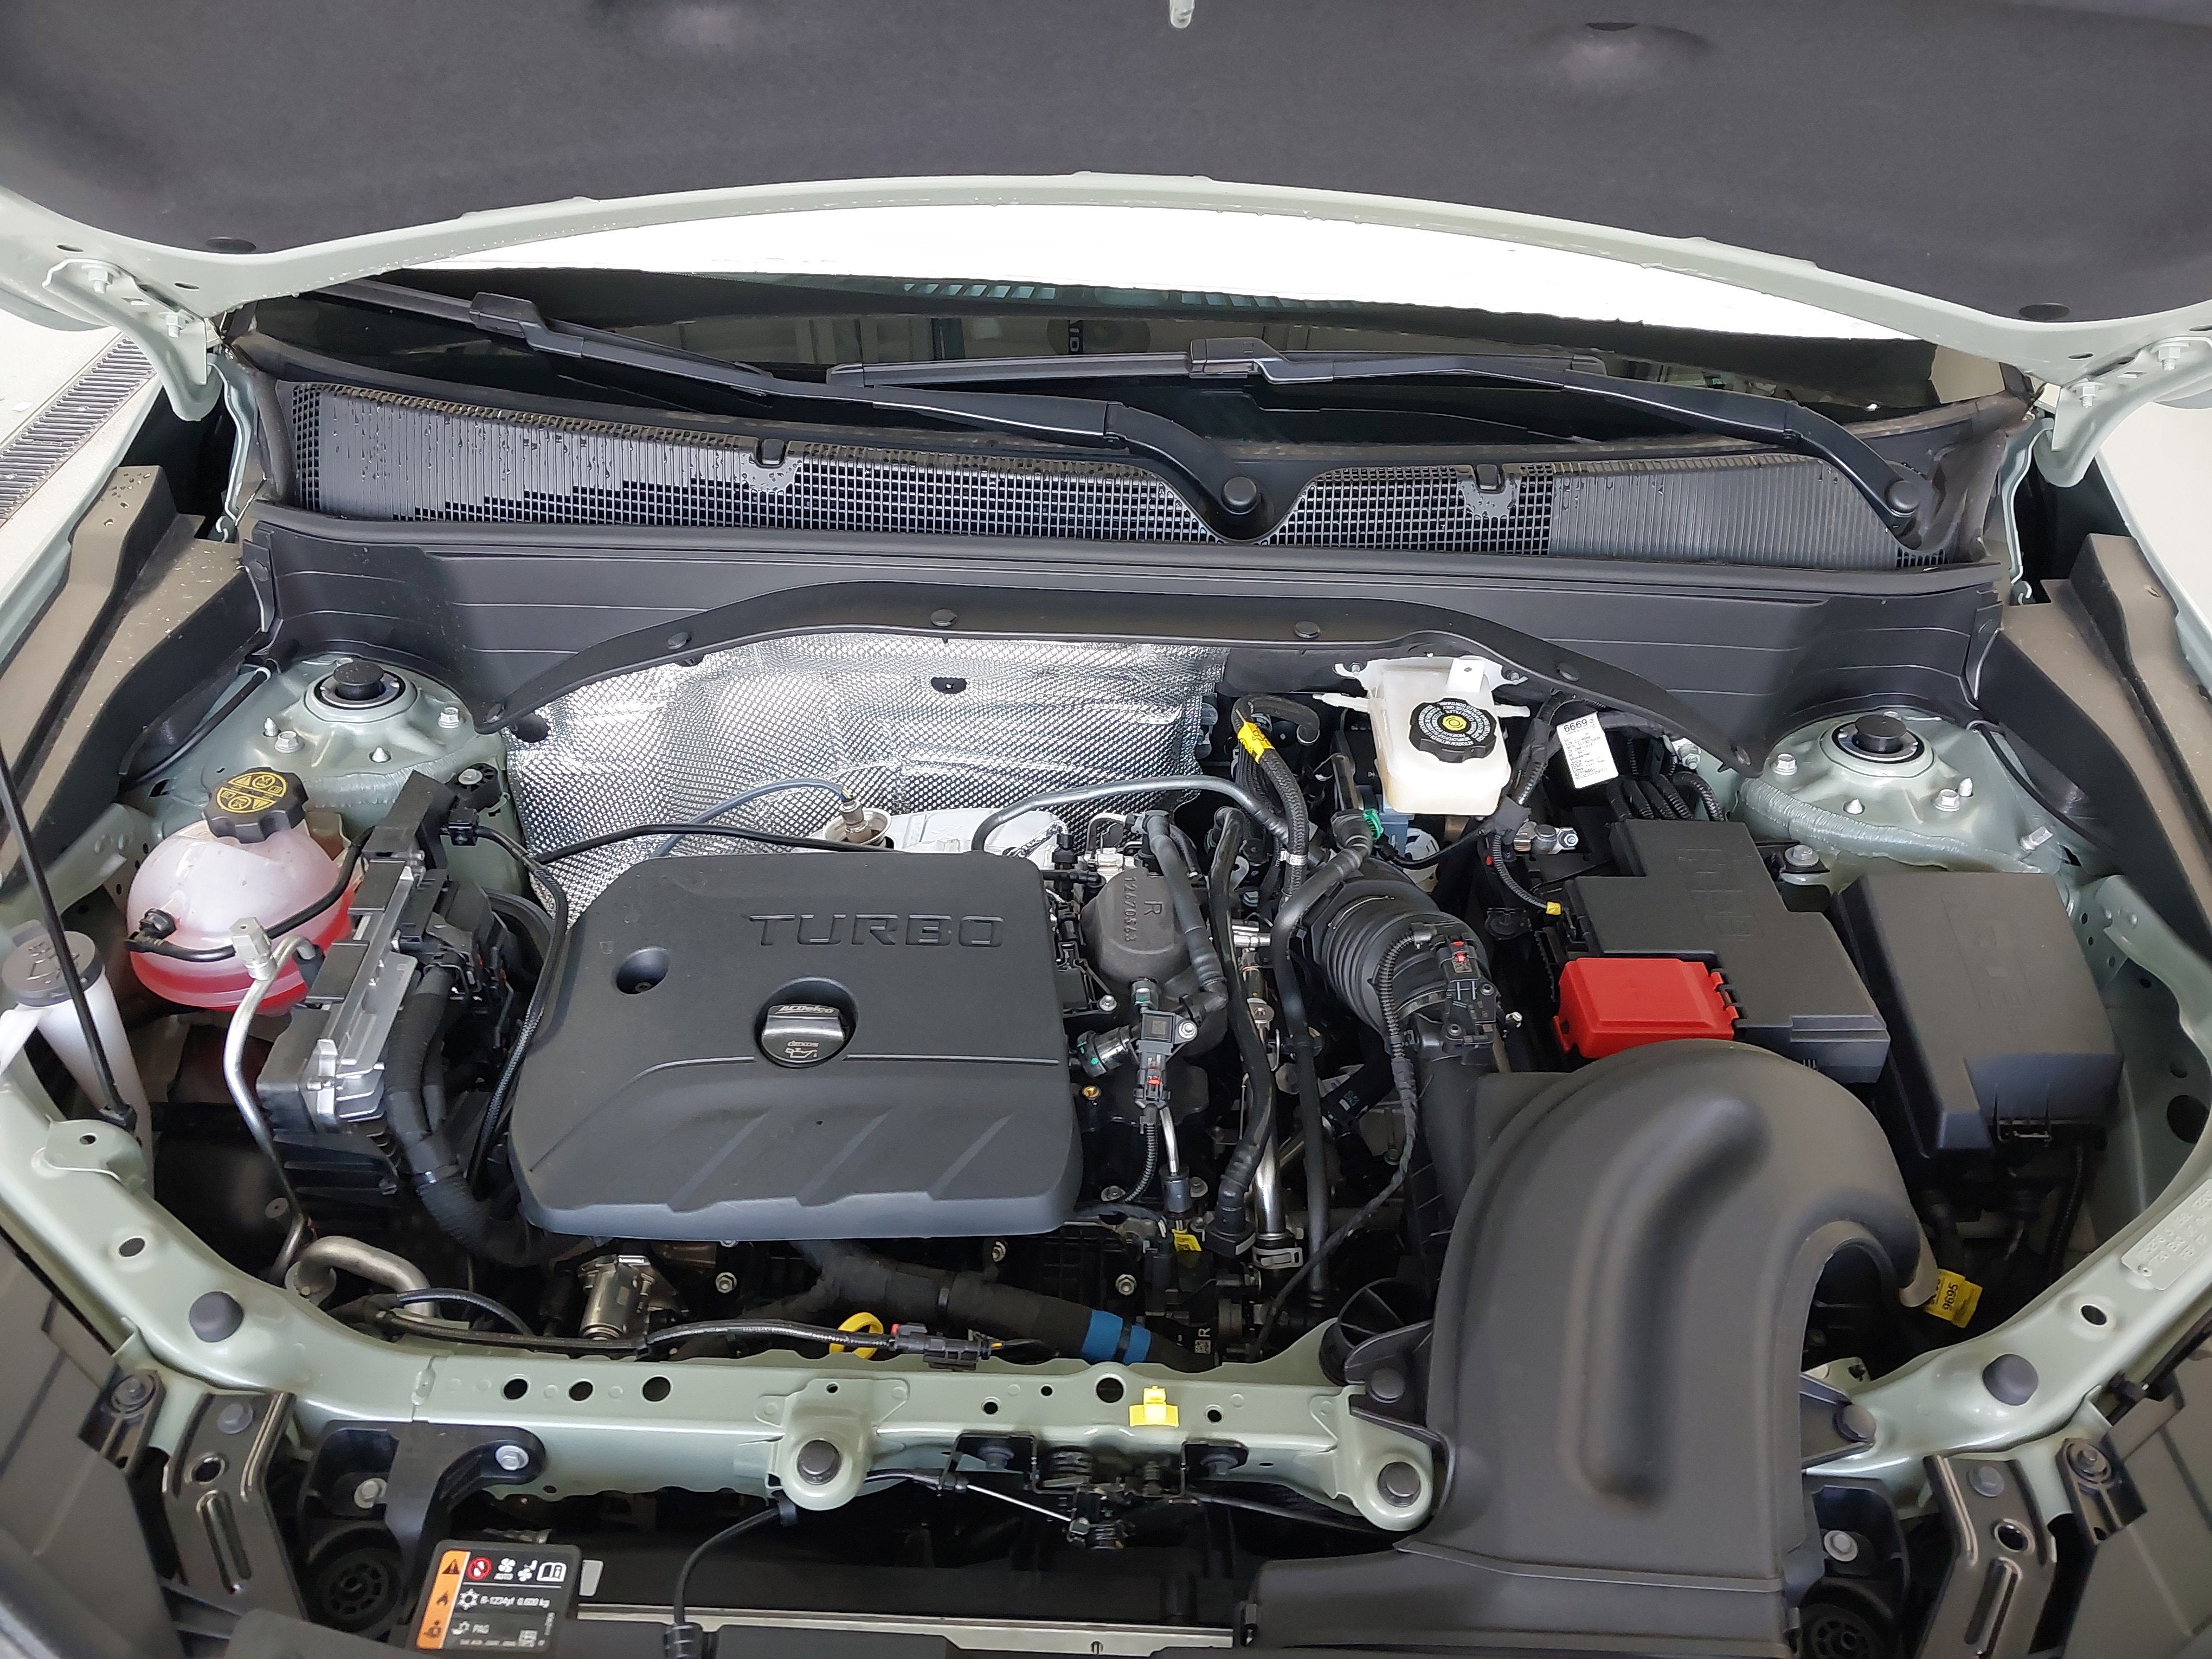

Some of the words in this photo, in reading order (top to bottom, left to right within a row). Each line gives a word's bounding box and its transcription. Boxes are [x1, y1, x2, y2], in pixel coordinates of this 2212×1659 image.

[1564, 719, 1587, 732] 6669
[1124, 877, 1137, 942] 12670563
[1143, 901, 1163, 916] R
[750, 914, 1004, 947] TURBO
[1942, 1282, 1959, 1311] 9695
[1198, 1328, 1211, 1338] R
